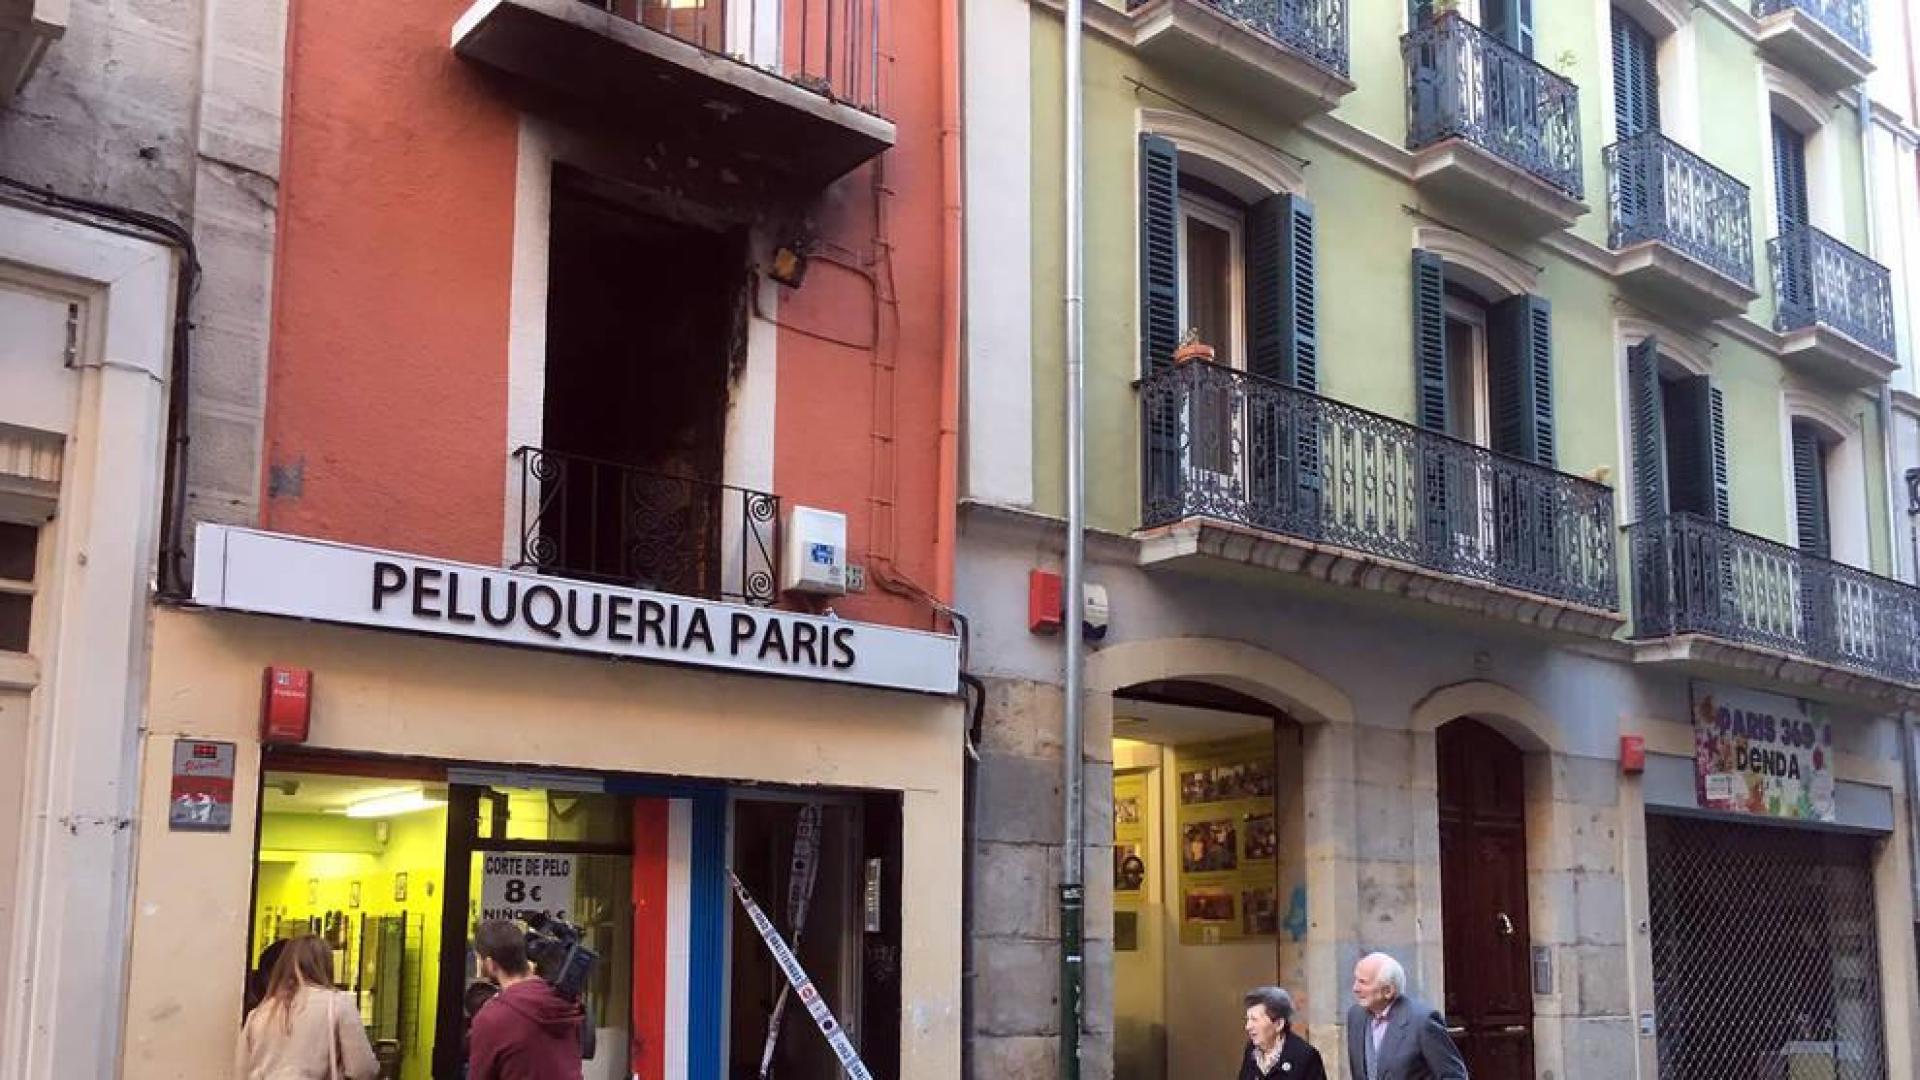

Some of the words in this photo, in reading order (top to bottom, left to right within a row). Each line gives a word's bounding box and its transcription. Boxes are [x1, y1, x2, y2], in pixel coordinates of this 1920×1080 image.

[372, 561, 715, 653] PELUQUERIA
[730, 612, 856, 669] PARIS
[1716, 705, 1776, 743] PARIS
[486, 856, 522, 876] CORTE
[525, 858, 540, 876] DE
[543, 859, 569, 877] PELO
[482, 907, 529, 920] NIÑO
